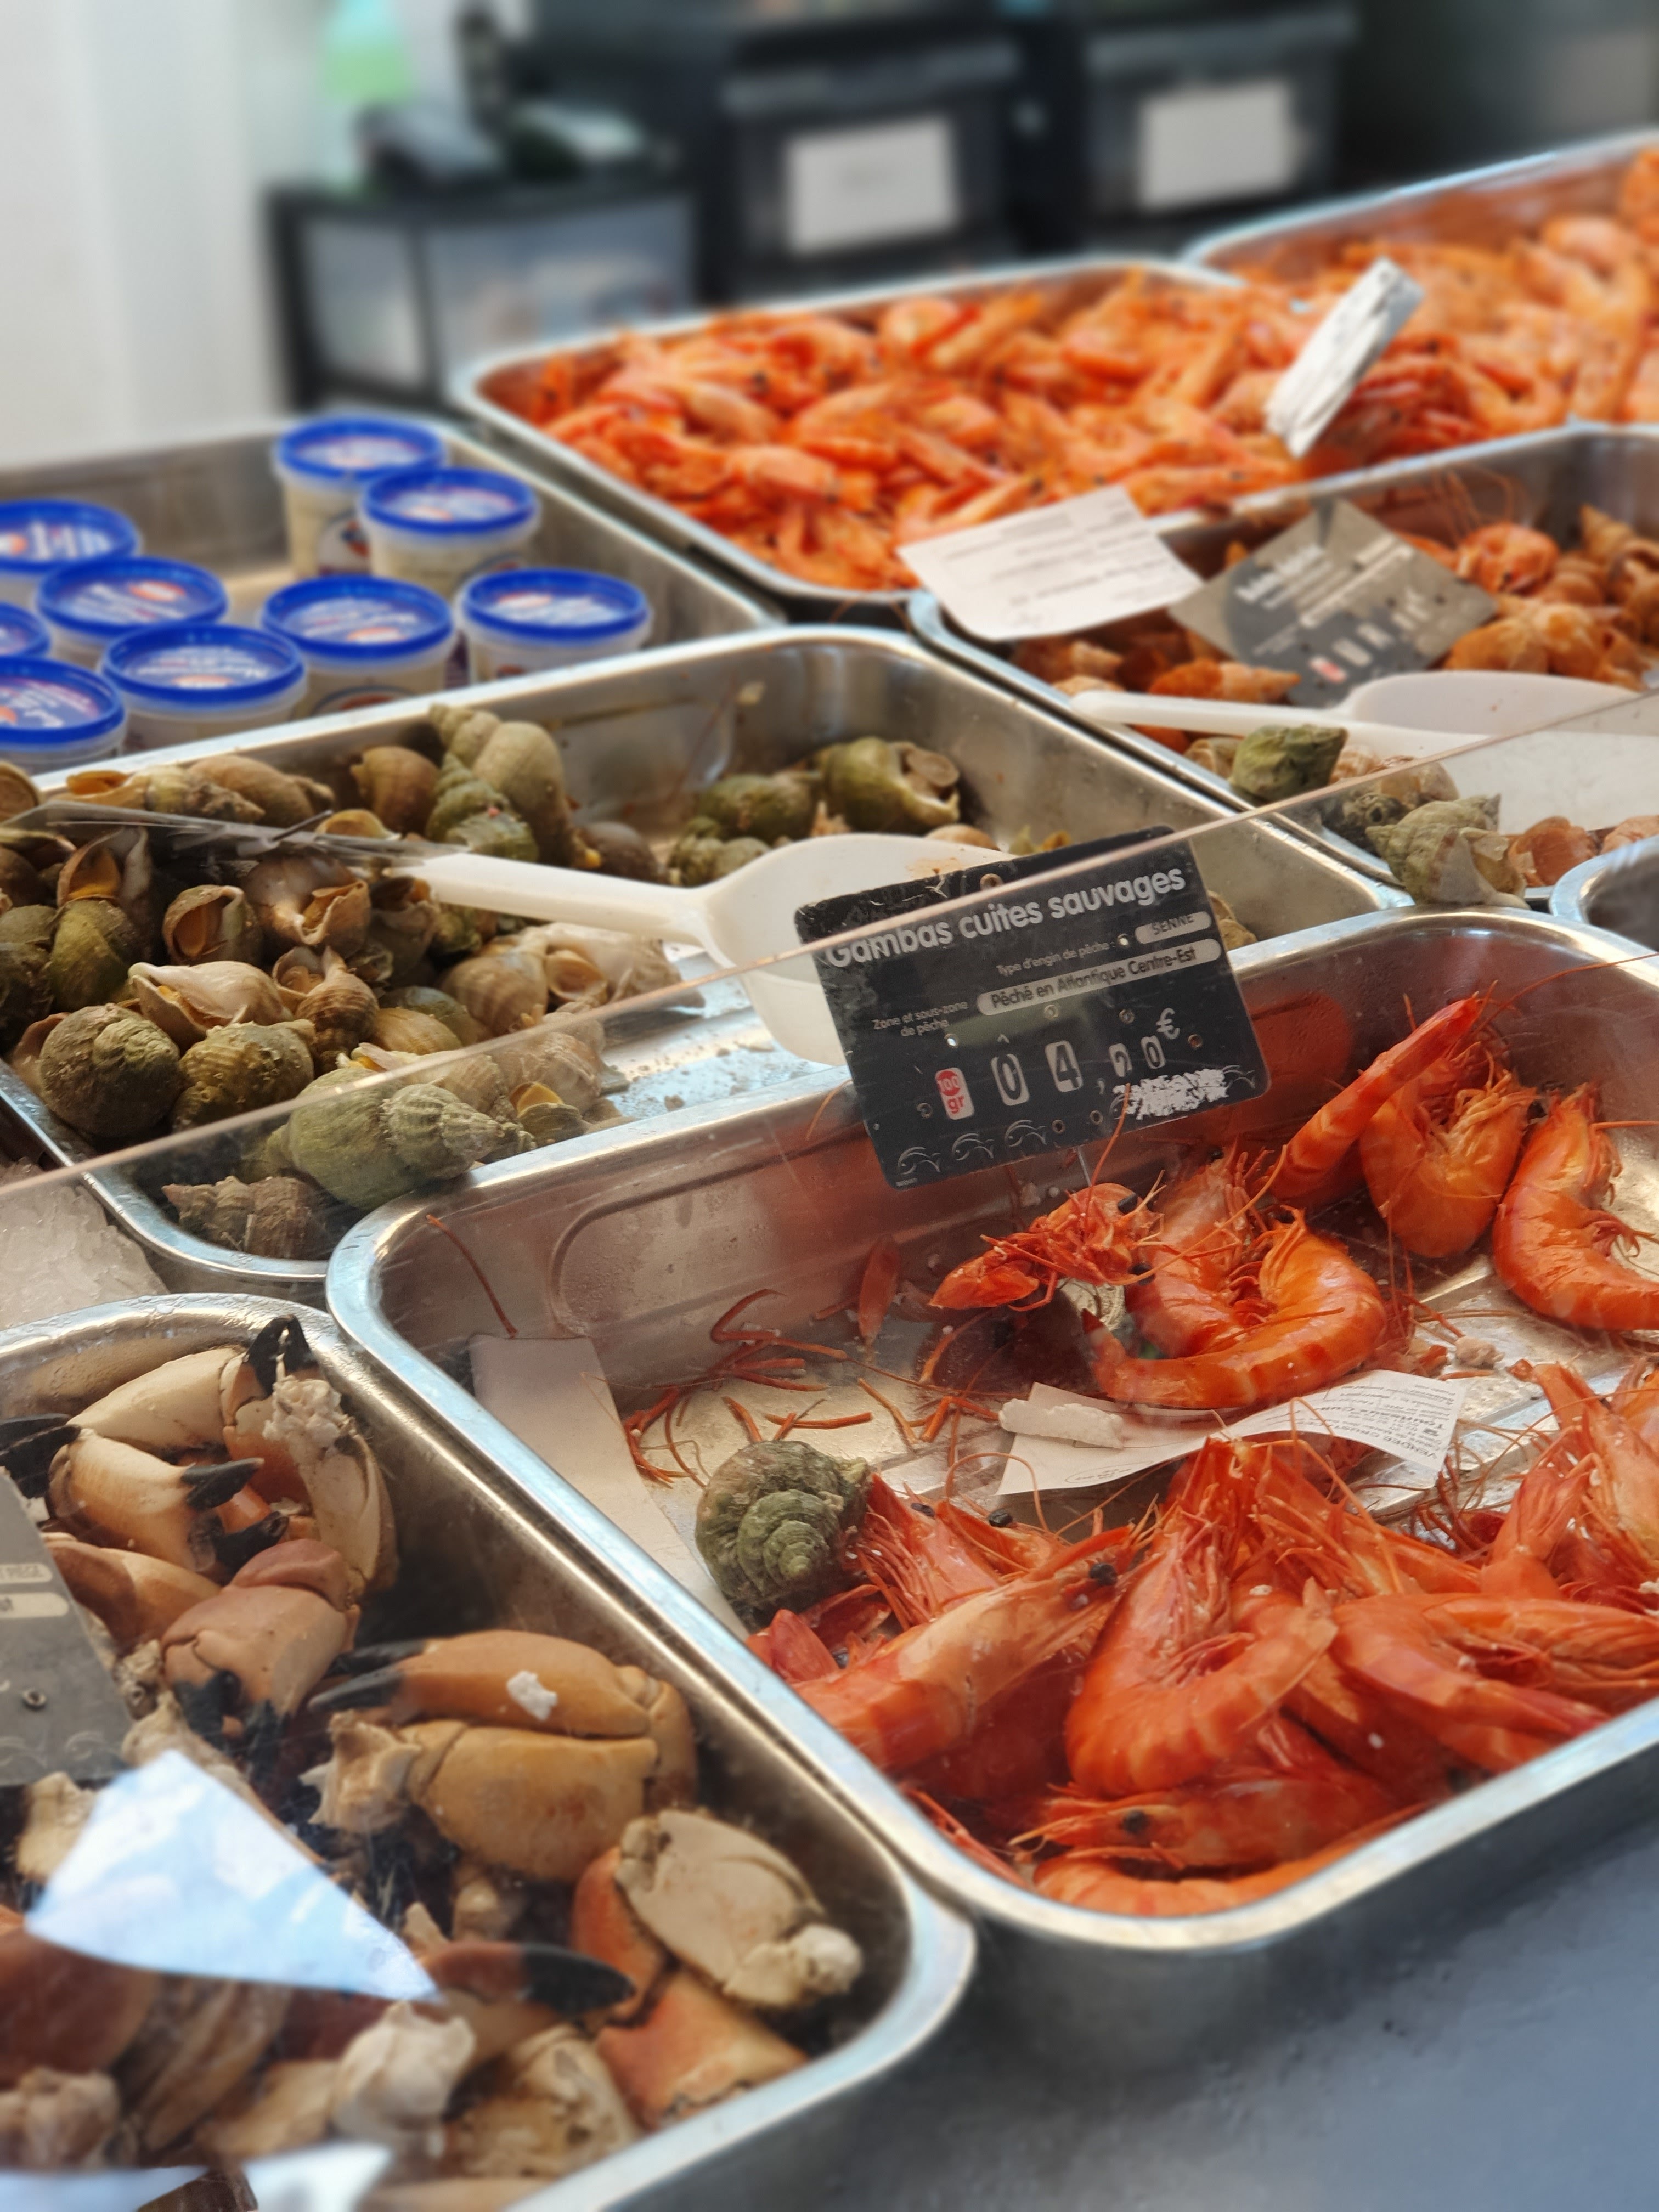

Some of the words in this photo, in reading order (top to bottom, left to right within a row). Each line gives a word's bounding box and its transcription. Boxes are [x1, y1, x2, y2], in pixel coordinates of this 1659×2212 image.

[825, 921, 954, 967] Gambas
[959, 902, 1043, 939] cuites
[1048, 868, 1186, 919] sauvages
[996, 962, 1022, 977] Type
[1023, 952, 1062, 969] d'engin
[1063, 948, 1077, 960] de
[1079, 941, 1110, 958] pêche
[1037, 984, 1054, 997] en
[1057, 968, 1126, 993] Atlantique
[1127, 946, 1197, 975] Centre-Est
[871, 1017, 901, 1030] Zone
[901, 1013, 913, 1023] et
[915, 1001, 969, 1020] sous-zone
[900, 1026, 916, 1037] de
[916, 1020, 950, 1036] pêche
[936, 1076, 961, 1092] 100
[947, 1095, 965, 1114] gr
